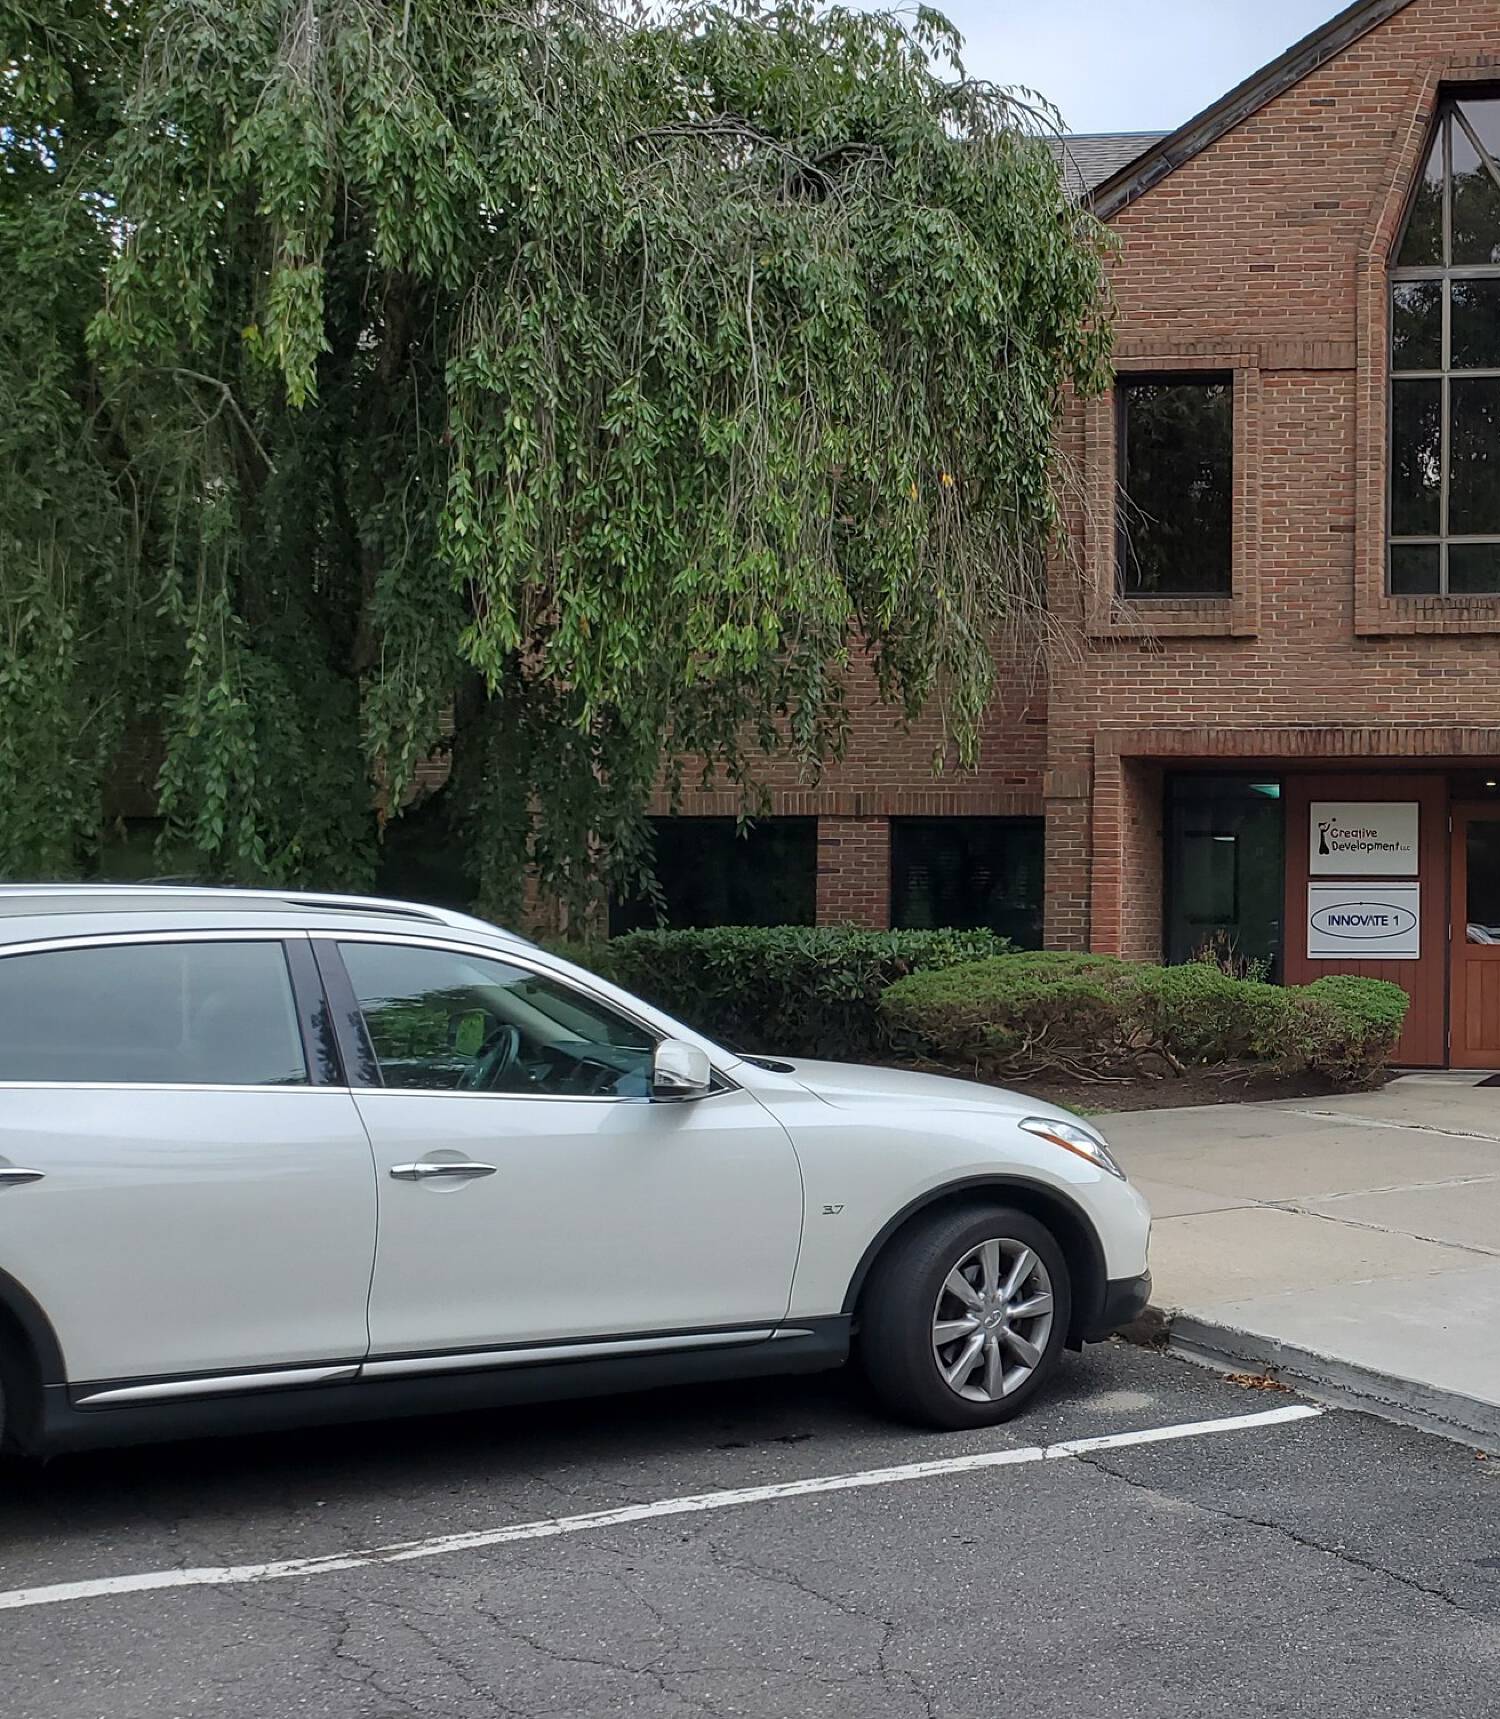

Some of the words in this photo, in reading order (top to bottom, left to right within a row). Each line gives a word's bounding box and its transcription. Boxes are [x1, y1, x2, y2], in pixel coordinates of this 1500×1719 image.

[1330, 828, 1378, 839] Creative
[1332, 840, 1399, 854] Development
[1328, 915, 1389, 926] INNOVATE
[1393, 915, 1399, 926] 1
